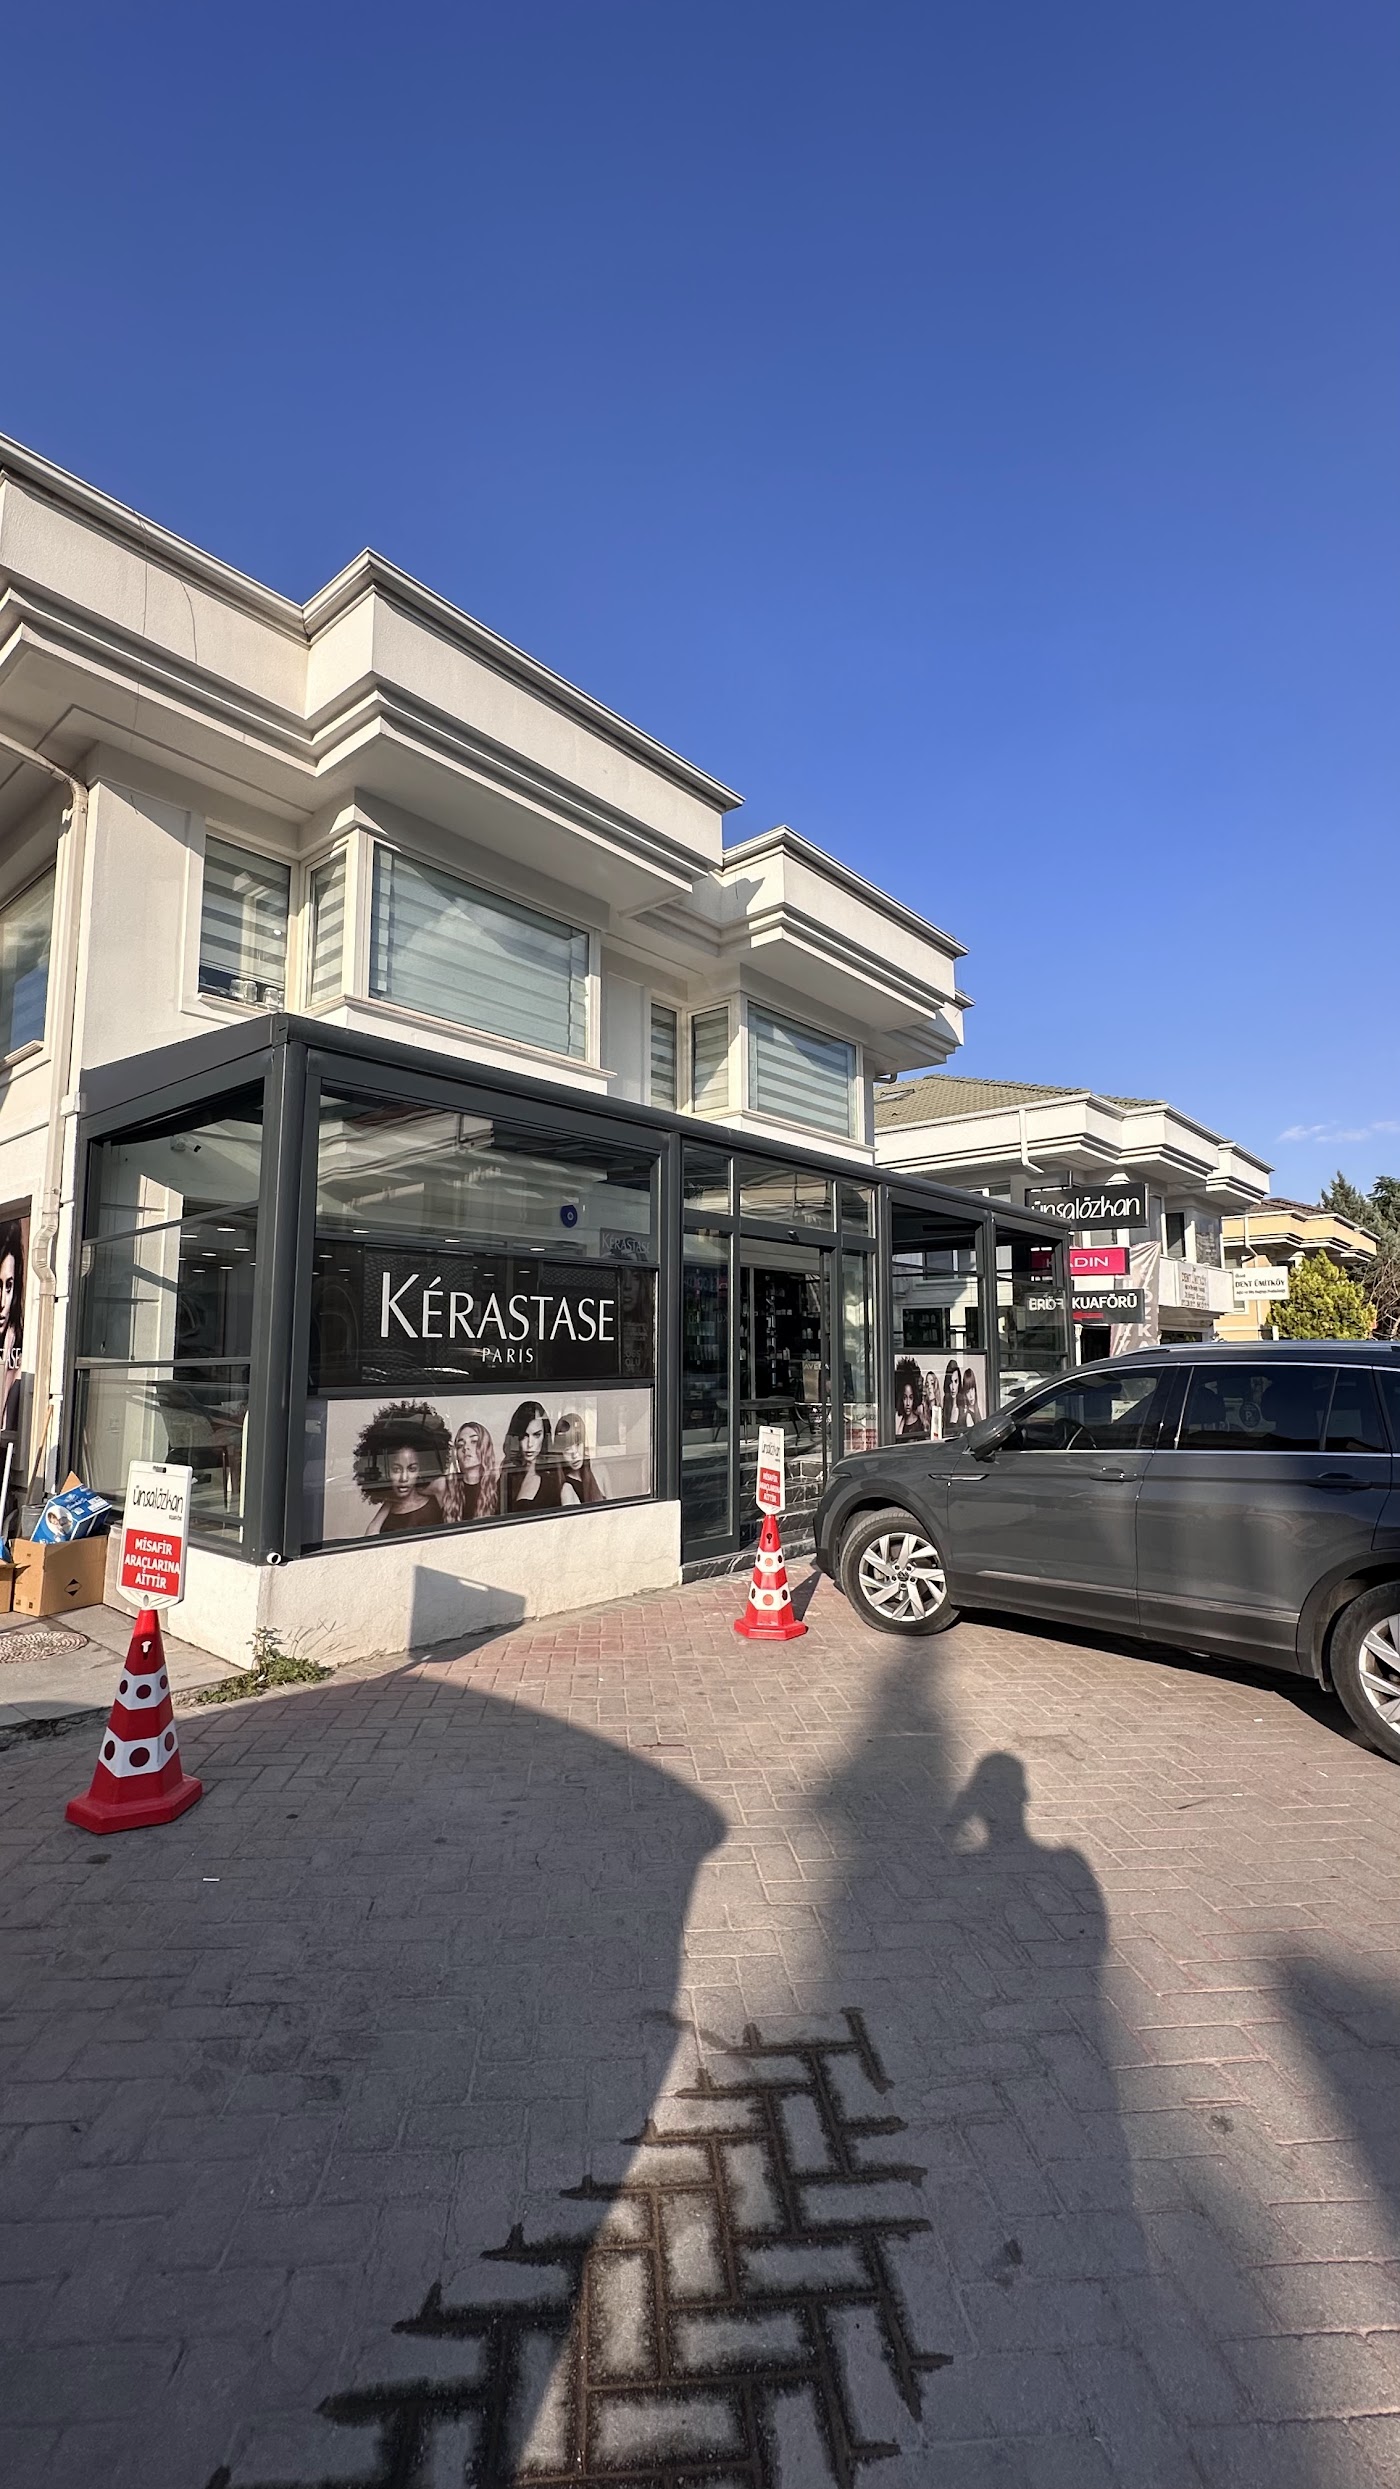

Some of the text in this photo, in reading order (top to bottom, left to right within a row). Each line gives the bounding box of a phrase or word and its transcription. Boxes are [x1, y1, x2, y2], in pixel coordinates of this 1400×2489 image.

[1235, 1280, 1252, 1288] DENT
[380, 1271, 615, 1342] KÉRASTASE
[1072, 1292, 1138, 1310] KUAFÖRÜ
[481, 1346, 534, 1364] PARIS
[135, 1536, 172, 1556] MİSAFİR
[125, 1553, 181, 1575] ARAÇLARINA
[135, 1571, 167, 1590] AİTTİR
